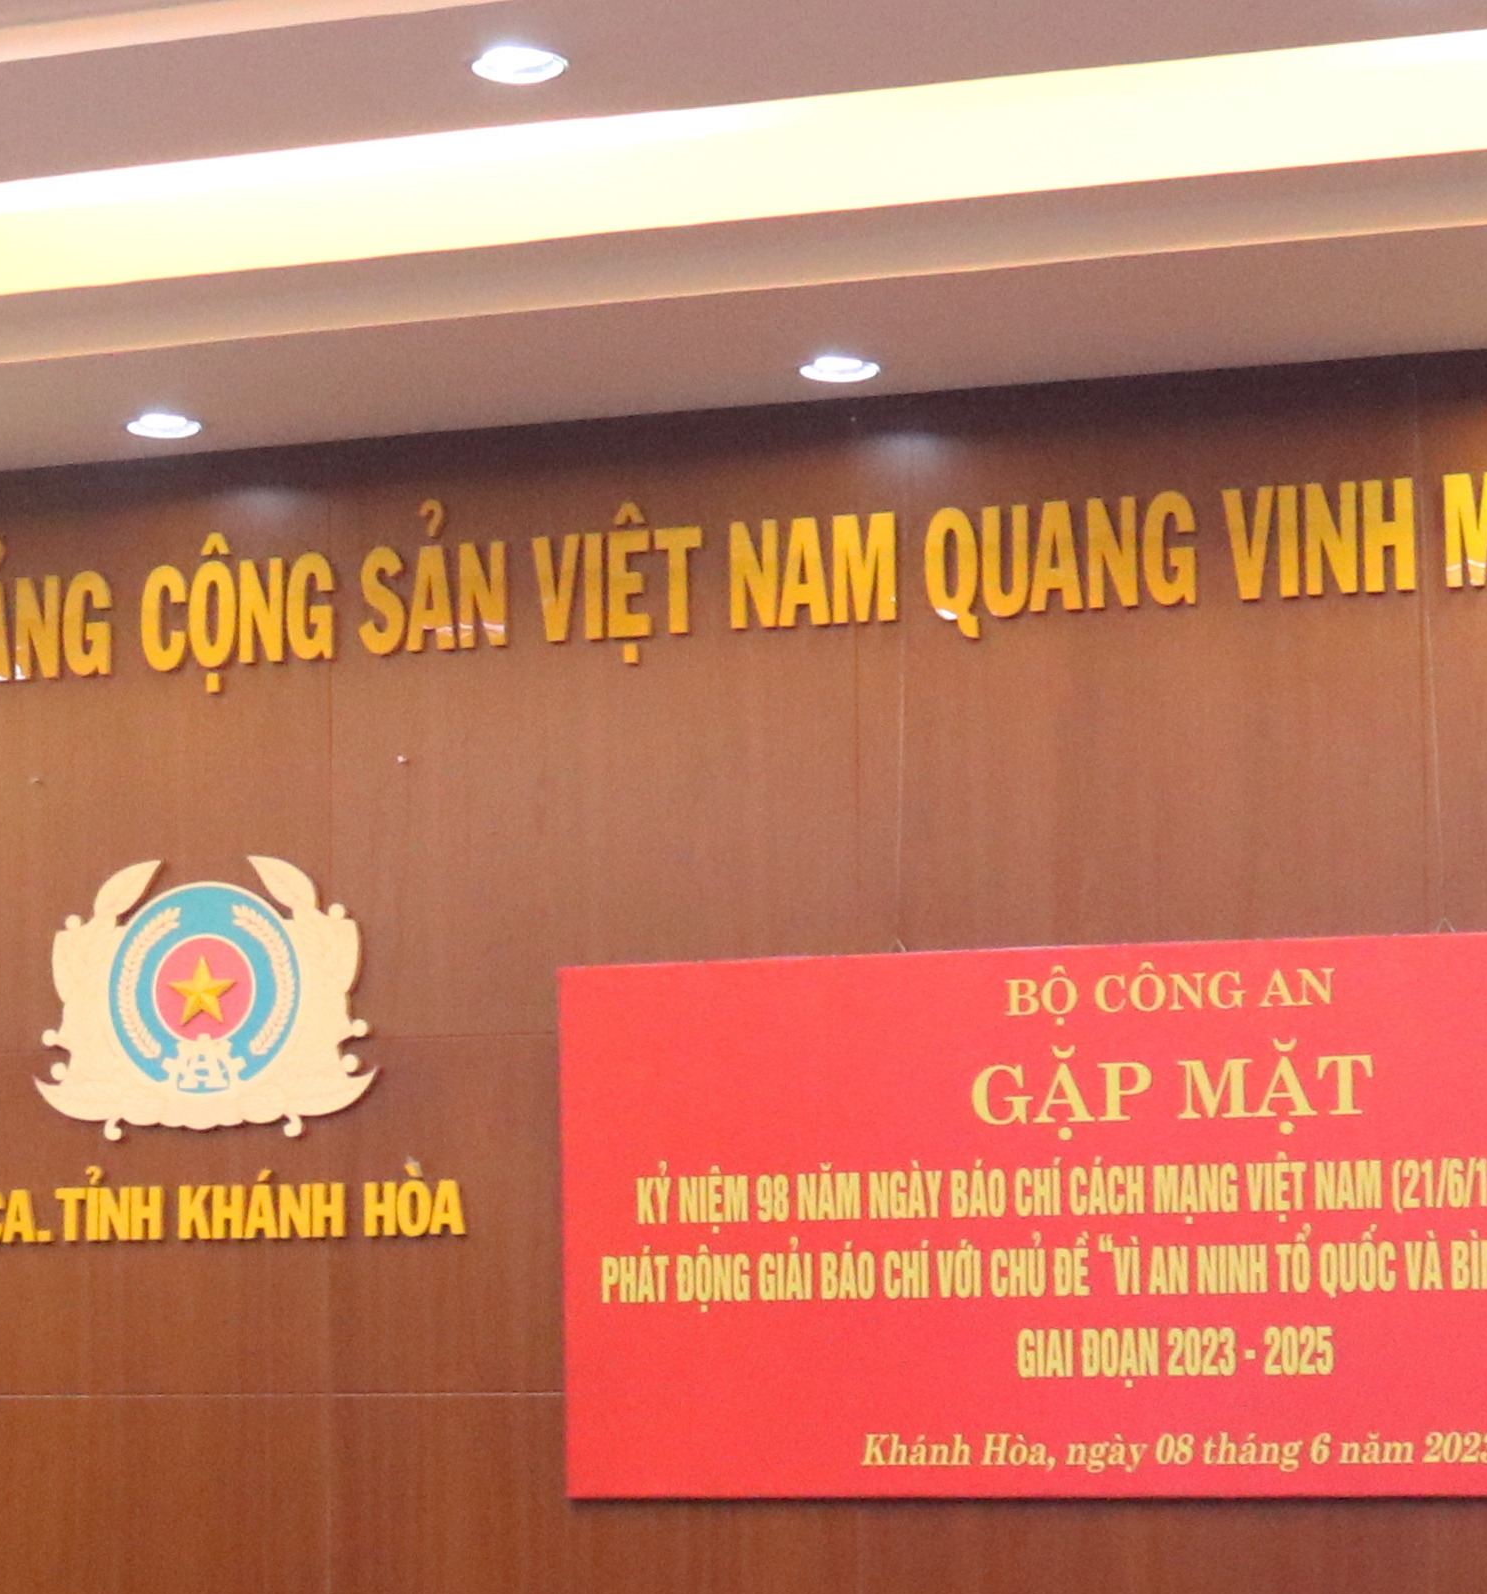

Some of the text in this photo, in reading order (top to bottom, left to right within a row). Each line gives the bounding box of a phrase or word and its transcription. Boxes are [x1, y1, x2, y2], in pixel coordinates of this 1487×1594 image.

[141, 532, 334, 693] CỘNG
[360, 499, 508, 656] SẢN
[532, 501, 702, 664] VIỆT
[730, 511, 897, 629] NAM
[924, 490, 1196, 639] QUANG
[1222, 477, 1417, 600] VINH
[1004, 961, 1335, 1026] BỘ CÔNG AN
[971, 1037, 1374, 1141] GẶP MẶT
[177, 1168, 345, 1241] KHÁNH
[363, 1157, 467, 1238] HÒA
[636, 1160, 671, 1225] KỶ
[678, 1165, 749, 1234] NIỆM
[756, 1173, 789, 1222] 98
[797, 1162, 861, 1221] NĂM
[869, 1159, 943, 1220] NGÀY
[950, 1158, 1006, 1218] BÁO
[1014, 1156, 1062, 1217] CHÍ
[1069, 1156, 1145, 1216] CÁCH
[1153, 1161, 1238, 1224] MẠNG
[1246, 1151, 1307, 1223] VIỆT
[1314, 1159, 1382, 1210] NAM
[601, 1244, 670, 1304] PHÁT
[676, 1244, 751, 1313] ĐỘNG
[758, 1235, 813, 1301] GIẢI
[820, 1240, 876, 1300] BÁO
[883, 1238, 930, 1299] CHÍ
[937, 1238, 983, 1298] VỚI
[989, 1230, 1047, 1298] CHỦ
[1053, 1230, 1092, 1297] ĐỀ
[1149, 1246, 1190, 1296] AN
[1196, 1243, 1268, 1294] NINH
[1275, 1222, 1312, 1293] TỔ
[1319, 1223, 1397, 1298] QUỐC
[1404, 1230, 1444, 1291] VÀ
[1015, 1328, 1074, 1379] GIAI
[1080, 1327, 1161, 1389] ĐOẠN
[1167, 1326, 1237, 1377] 2023
[1263, 1325, 1335, 1375] 2025
[860, 1432, 972, 1467] Khánh
[981, 1433, 1057, 1471] Hòa,
[1065, 1437, 1148, 1474] ngày
[1155, 1433, 1194, 1466] 08
[1203, 1431, 1301, 1473] tháng
[1309, 1432, 1331, 1464] 6
[1338, 1432, 1415, 1464] năm
